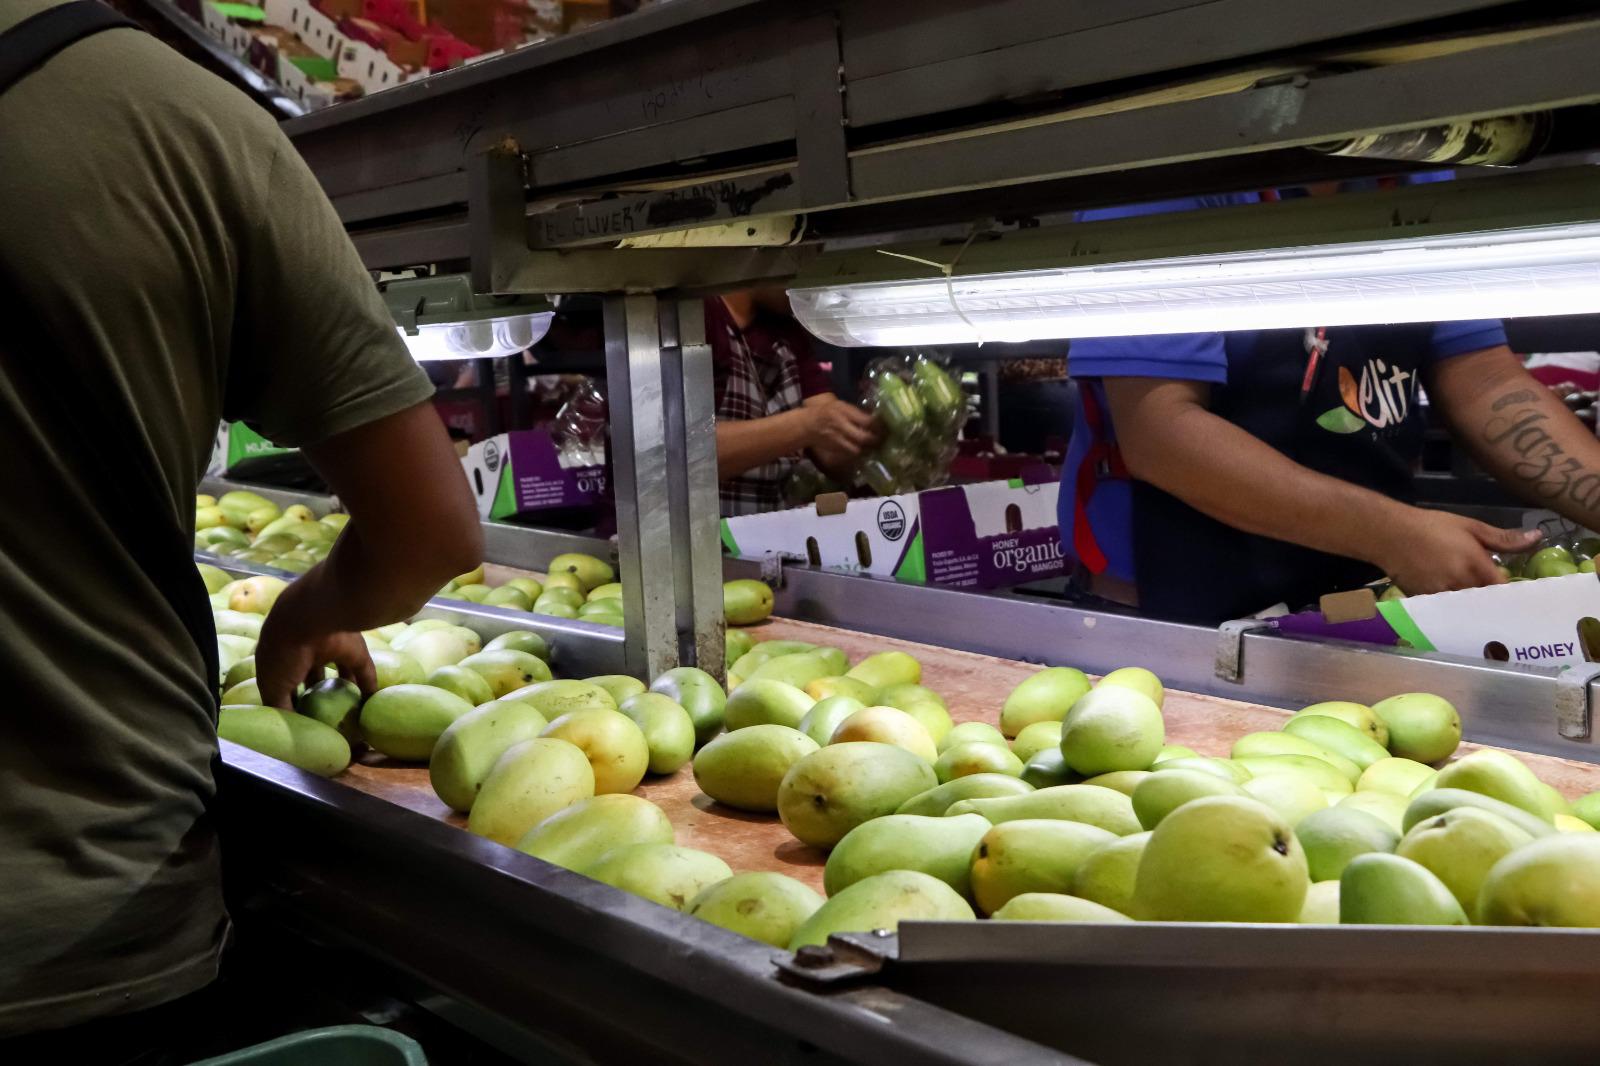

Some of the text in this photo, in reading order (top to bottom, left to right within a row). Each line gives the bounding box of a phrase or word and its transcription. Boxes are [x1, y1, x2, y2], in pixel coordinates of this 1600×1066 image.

[882, 509, 899, 521] USDA
[992, 537, 1020, 550] HONEY
[993, 537, 1066, 572] organic
[1031, 559, 1065, 573] MANGOS
[1514, 642, 1574, 661] HONEY
